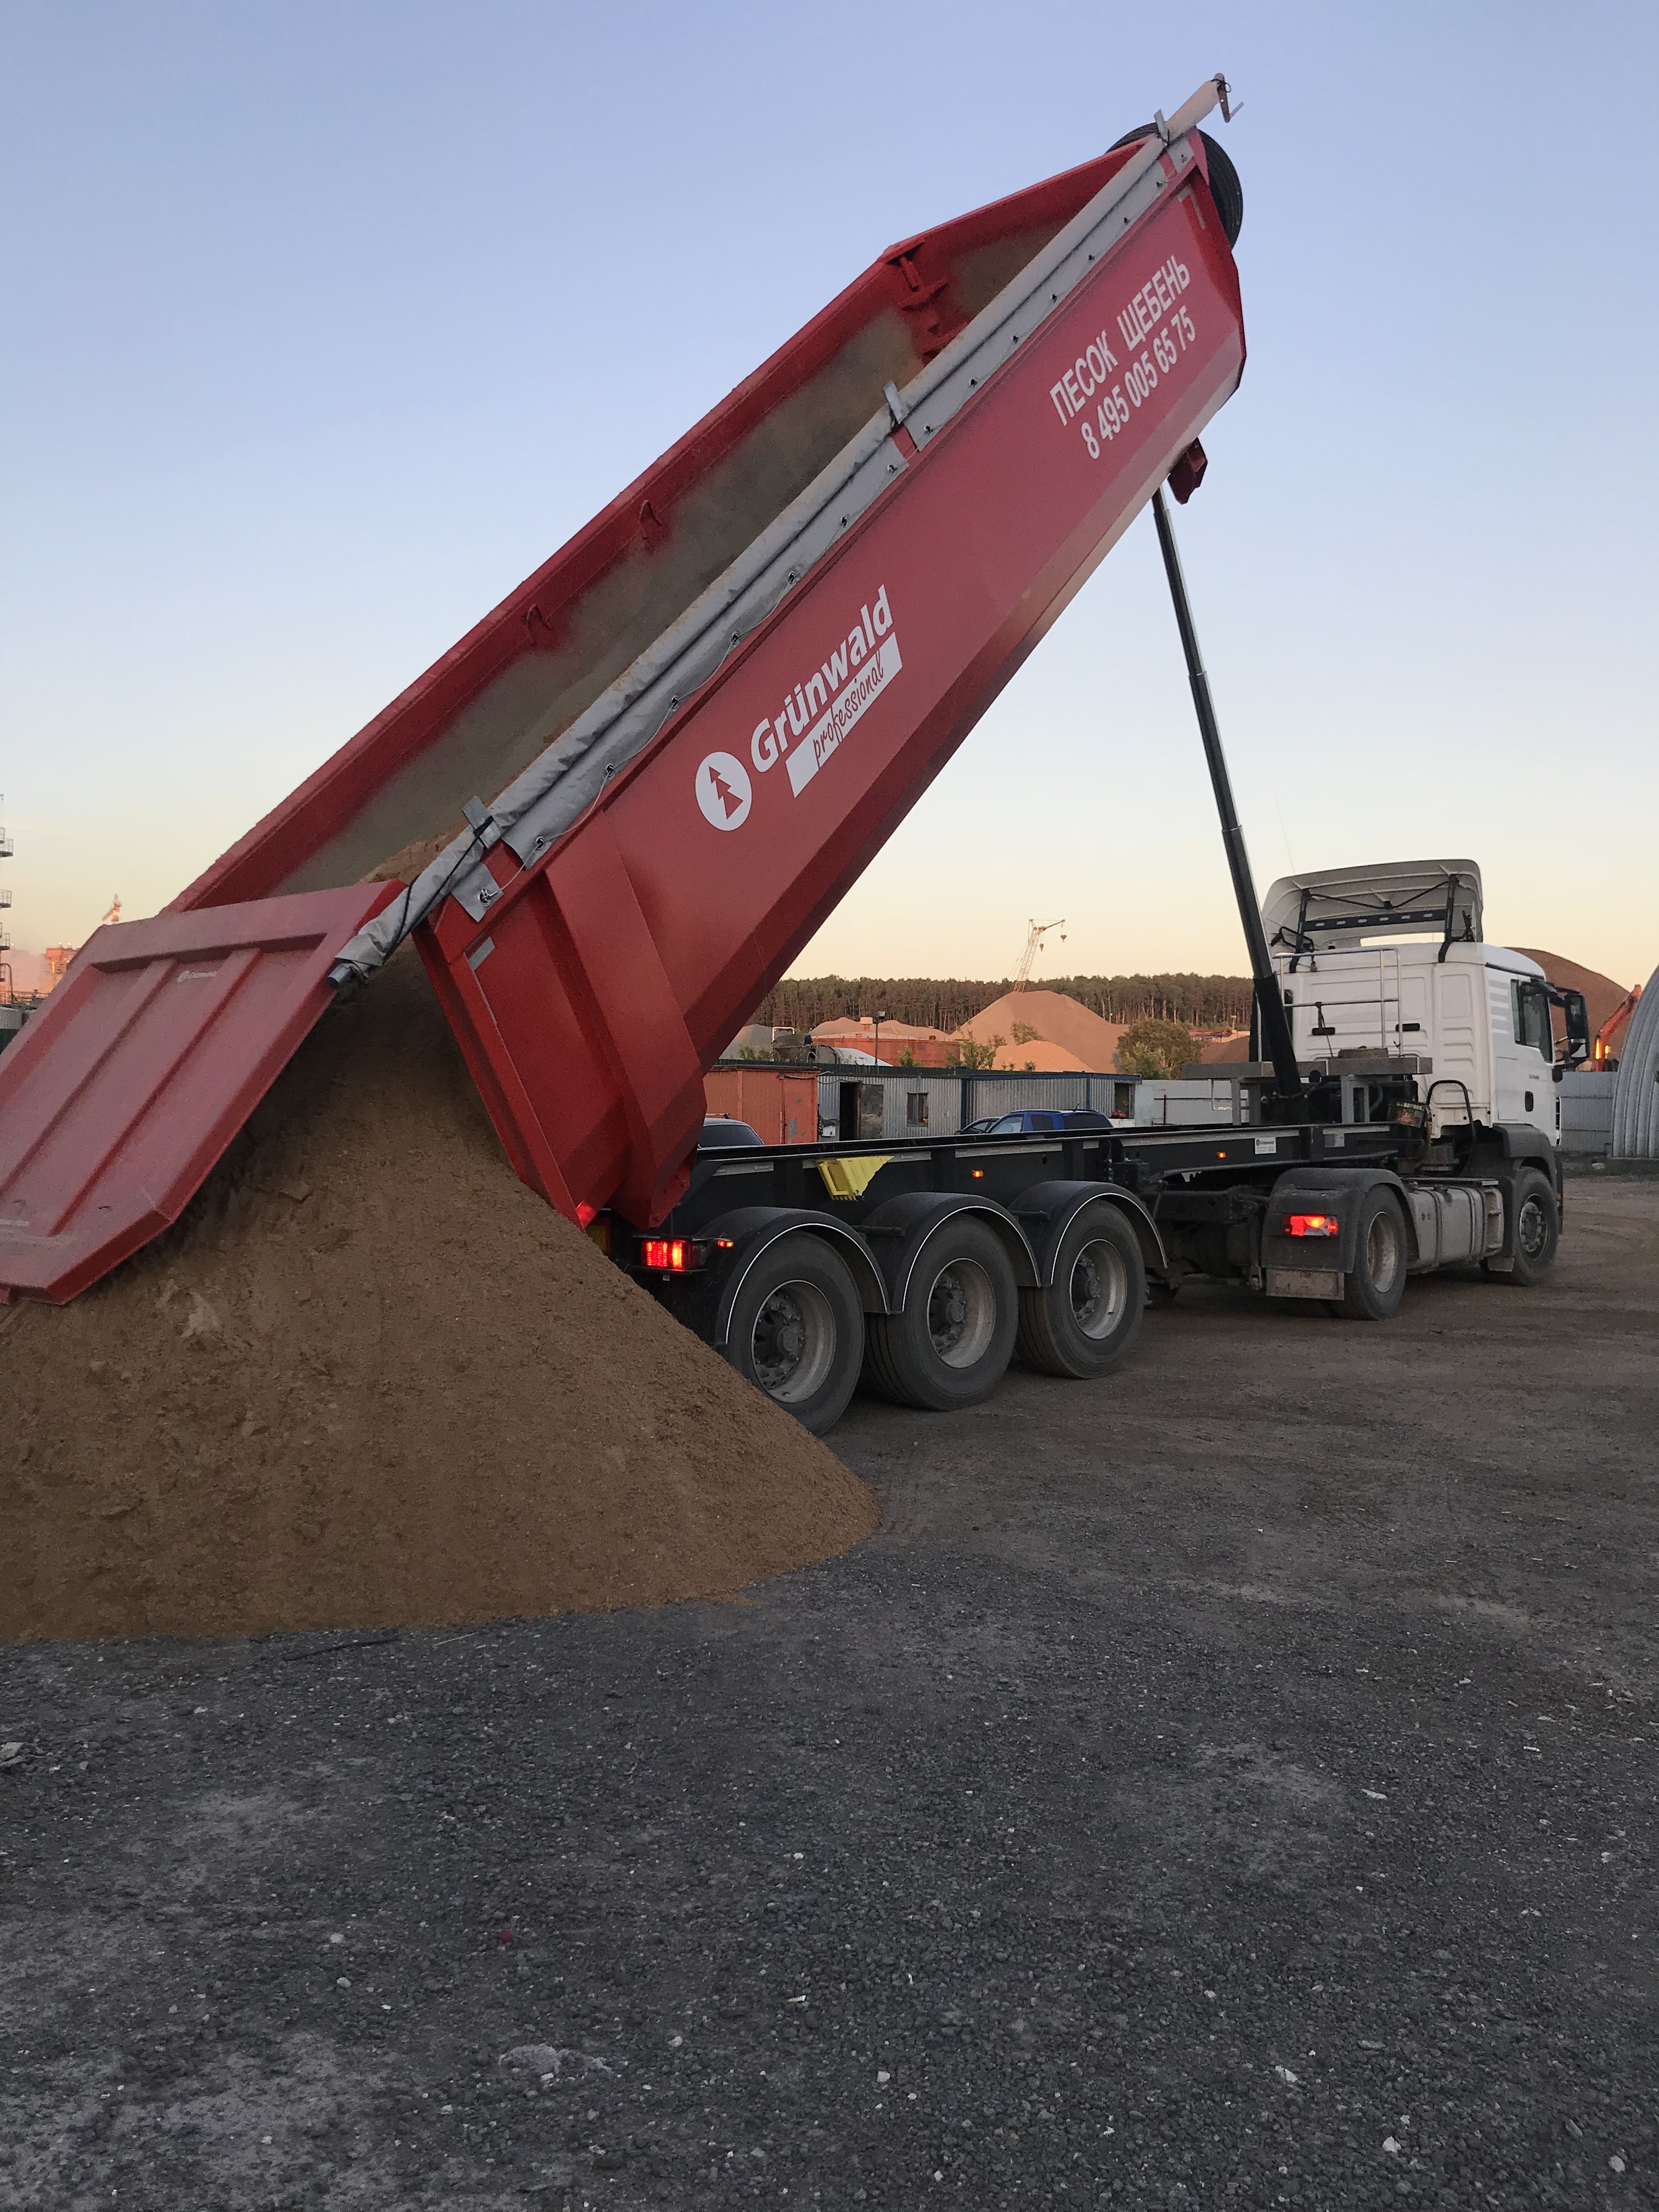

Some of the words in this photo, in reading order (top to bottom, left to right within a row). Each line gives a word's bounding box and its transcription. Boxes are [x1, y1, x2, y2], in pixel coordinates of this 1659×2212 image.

[1050, 330, 1119, 426] ПЕСОК
[1116, 255, 1190, 351] ЩЕБЕНЬ
[1081, 422, 1100, 459] 8
[1097, 385, 1130, 441] 495
[1124, 351, 1158, 408] 005
[1153, 327, 1177, 374] 65
[1171, 305, 1196, 351] 75
[751, 584, 893, 772] Grünwald
[812, 650, 884, 769] professional
